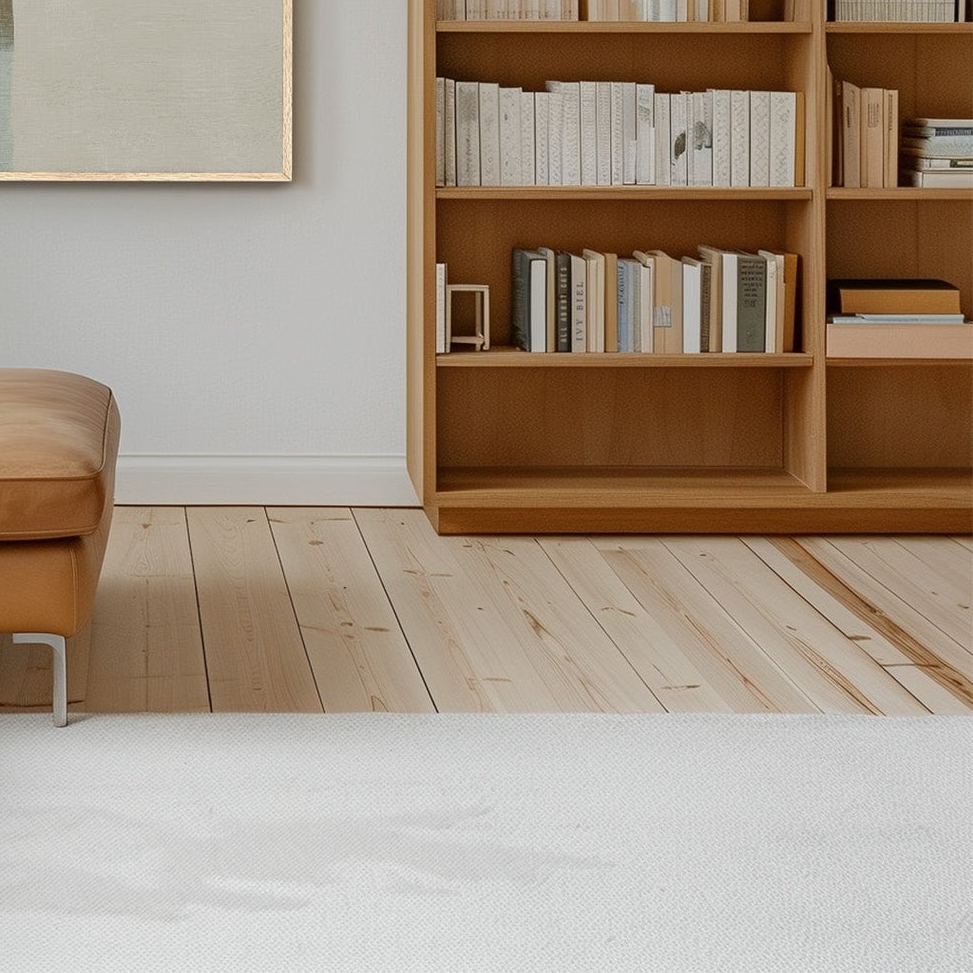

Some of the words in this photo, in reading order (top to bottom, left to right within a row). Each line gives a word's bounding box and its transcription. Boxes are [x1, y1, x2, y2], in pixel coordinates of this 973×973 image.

[576, 281, 584, 311] BIEL
[560, 327, 568, 343] ALL
[576, 318, 584, 341] IVY
